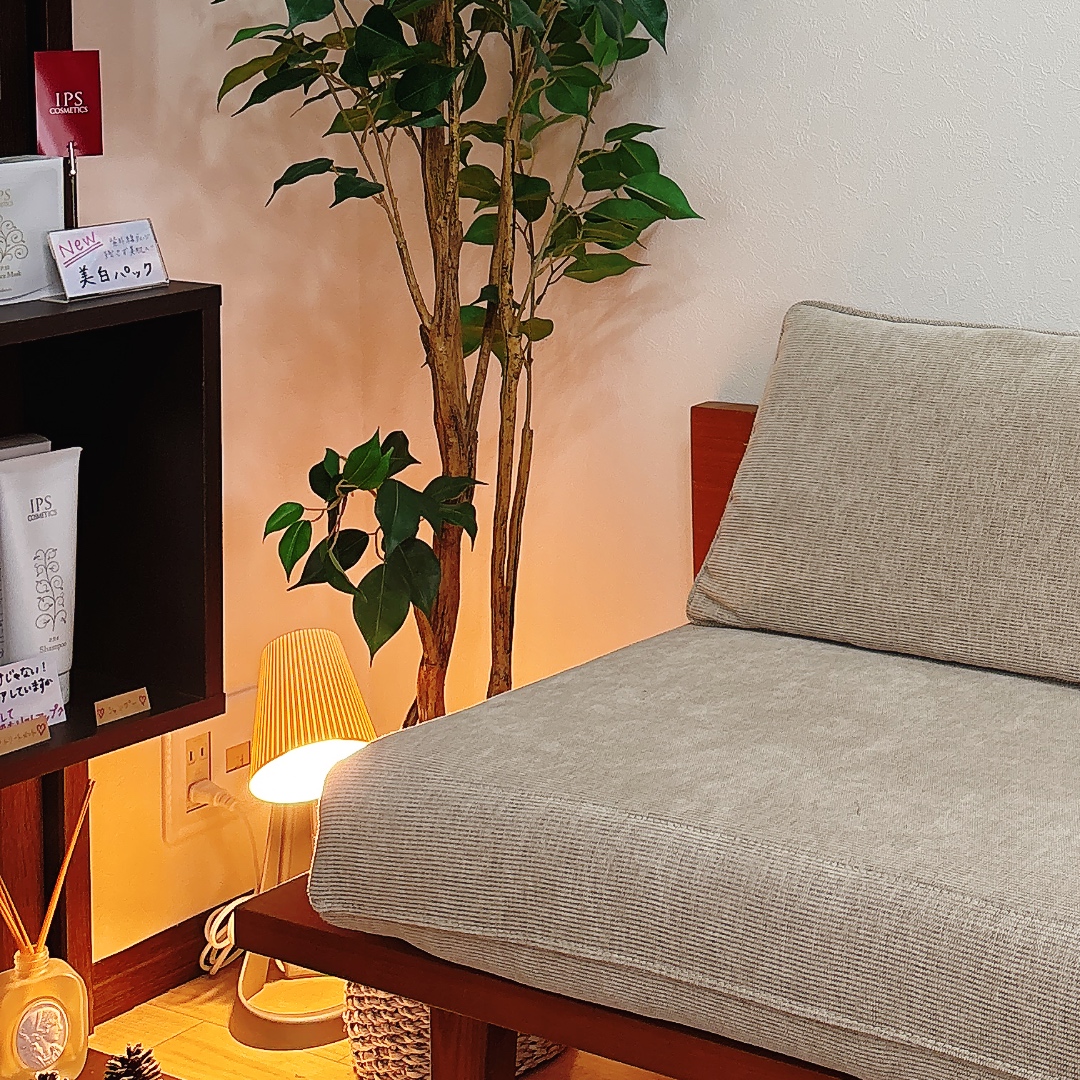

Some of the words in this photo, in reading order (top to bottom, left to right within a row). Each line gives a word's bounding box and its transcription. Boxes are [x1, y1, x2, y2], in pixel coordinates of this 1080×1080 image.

[56, 91, 82, 106] IPS
[49, 106, 88, 114] COSMETICS
[58, 232, 96, 258] New
[79, 262, 152, 288] 美白パック
[30, 494, 52, 514] IPS
[27, 509, 58, 522] COSMETICS
[40, 642, 67, 654] Shampoo
